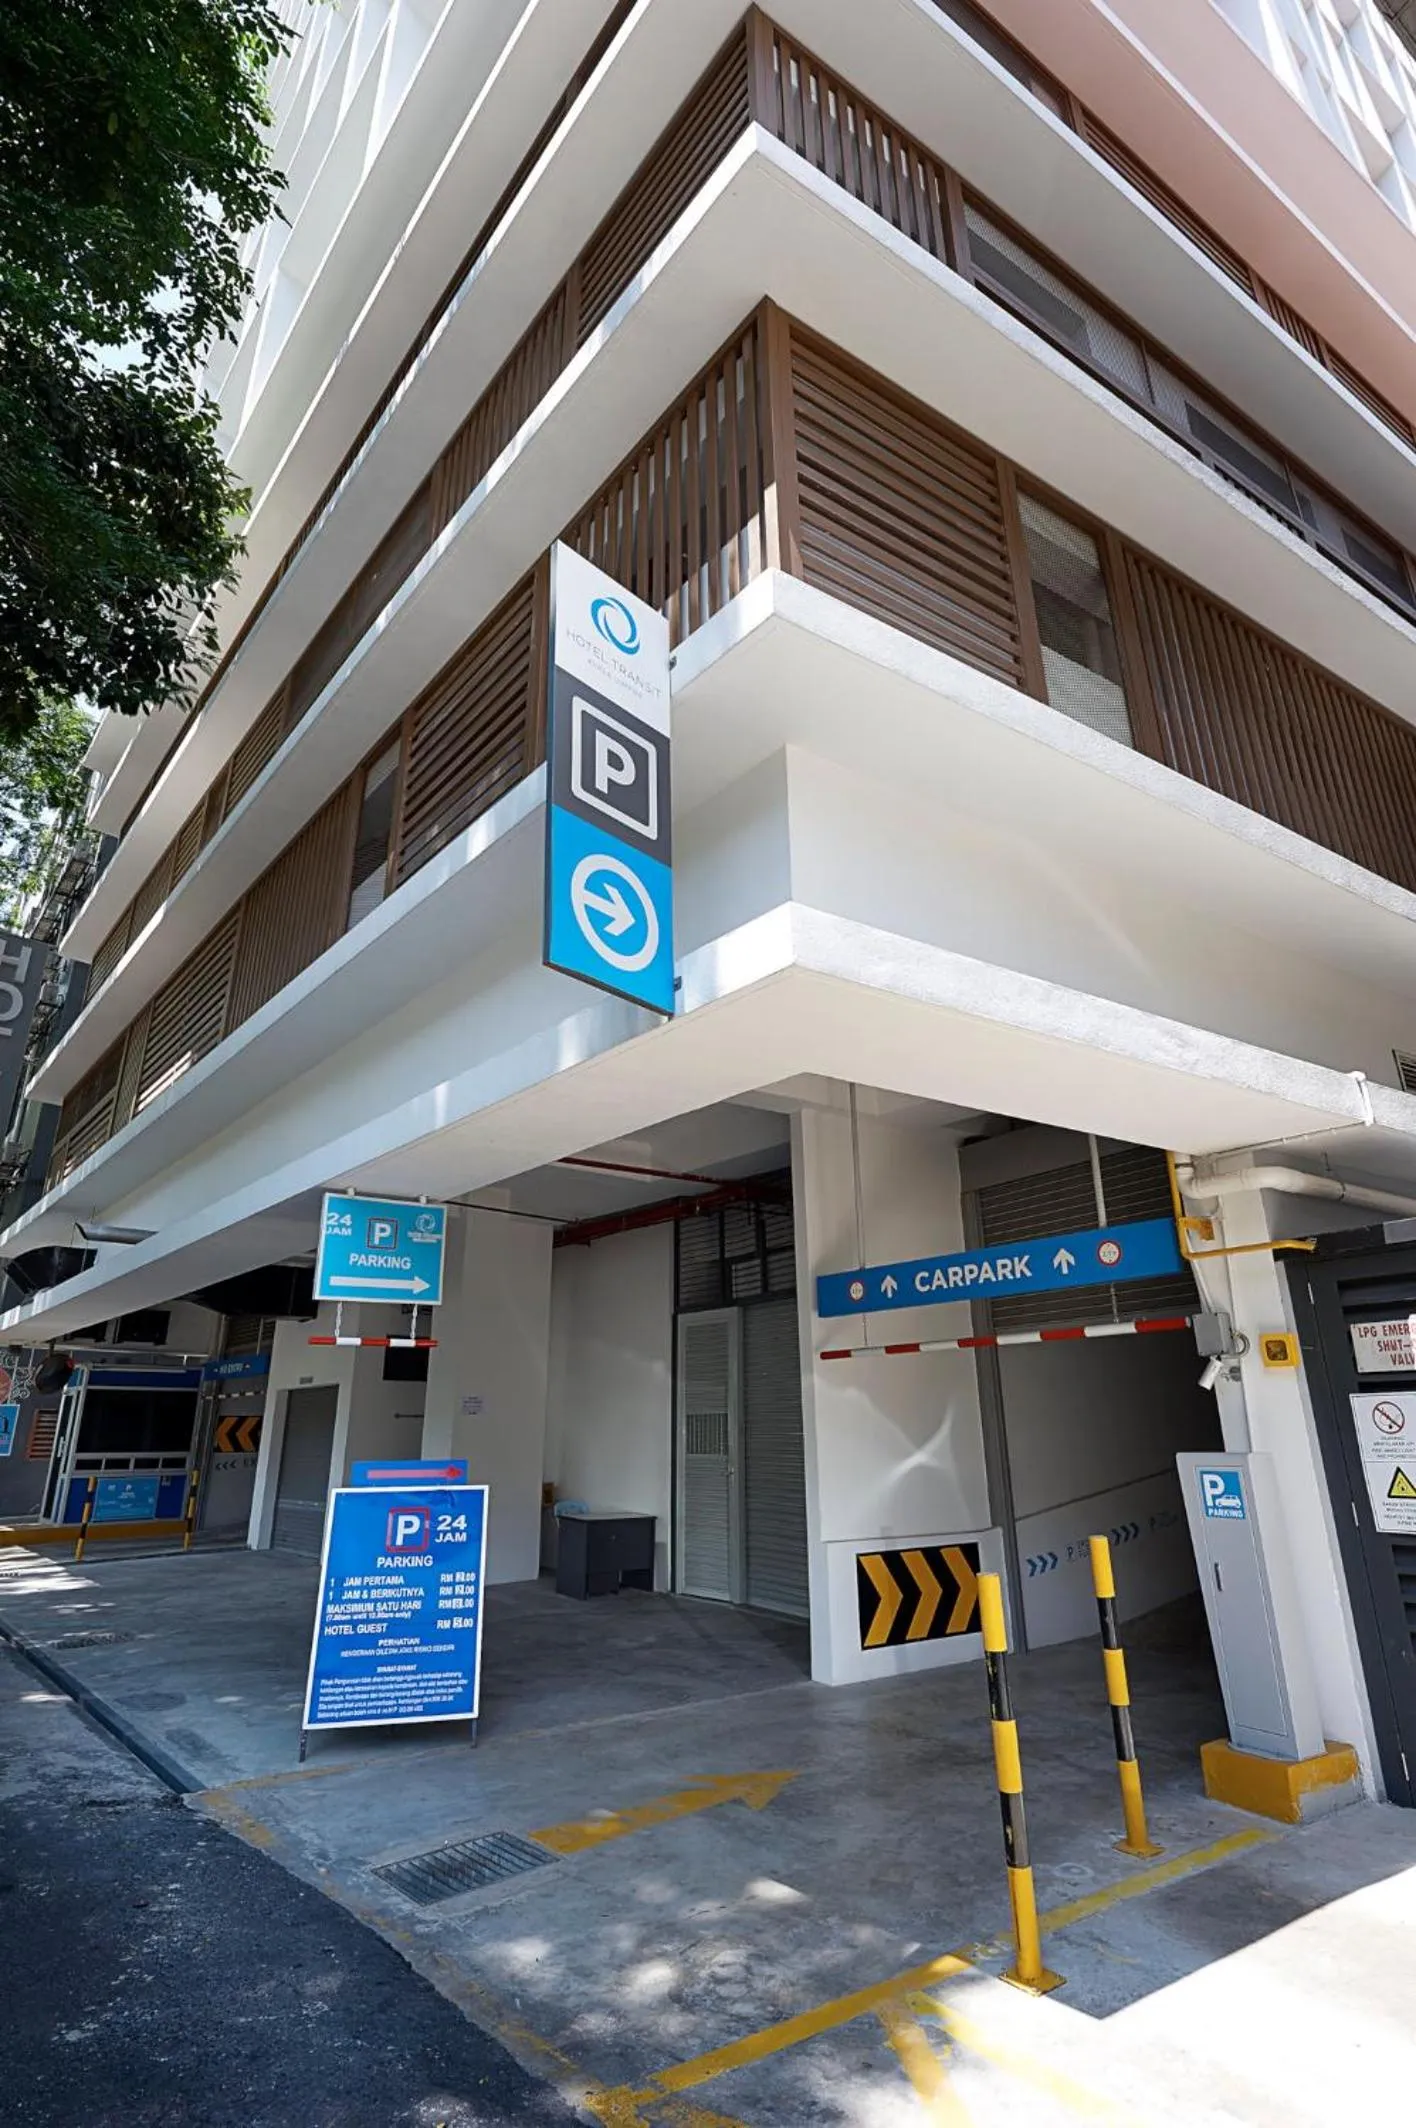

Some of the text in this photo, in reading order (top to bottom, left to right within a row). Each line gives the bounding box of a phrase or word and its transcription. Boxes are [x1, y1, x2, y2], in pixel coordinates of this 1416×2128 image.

[566, 627, 608, 664] HOTEL
[595, 729, 636, 794] P
[327, 1212, 352, 1226] 24
[373, 1222, 391, 1246] P
[348, 1252, 412, 1270] PARKING
[914, 1255, 1033, 1293] CARPARK
[1358, 1323, 1412, 1338] LPG EMER
[1202, 1473, 1226, 1507] P
[395, 1515, 421, 1546] P
[436, 1514, 468, 1531] 24
[434, 1532, 467, 1543] JAM
[376, 1555, 434, 1569] PARKING
[343, 1576, 362, 1587] JAM
[363, 1575, 404, 1586] PERTAMA
[341, 1590, 361, 1600] JAM
[370, 1587, 425, 1599] BERIKUTNYA
[324, 1624, 355, 1636] HOTEL
[357, 1622, 388, 1634] GUEST
